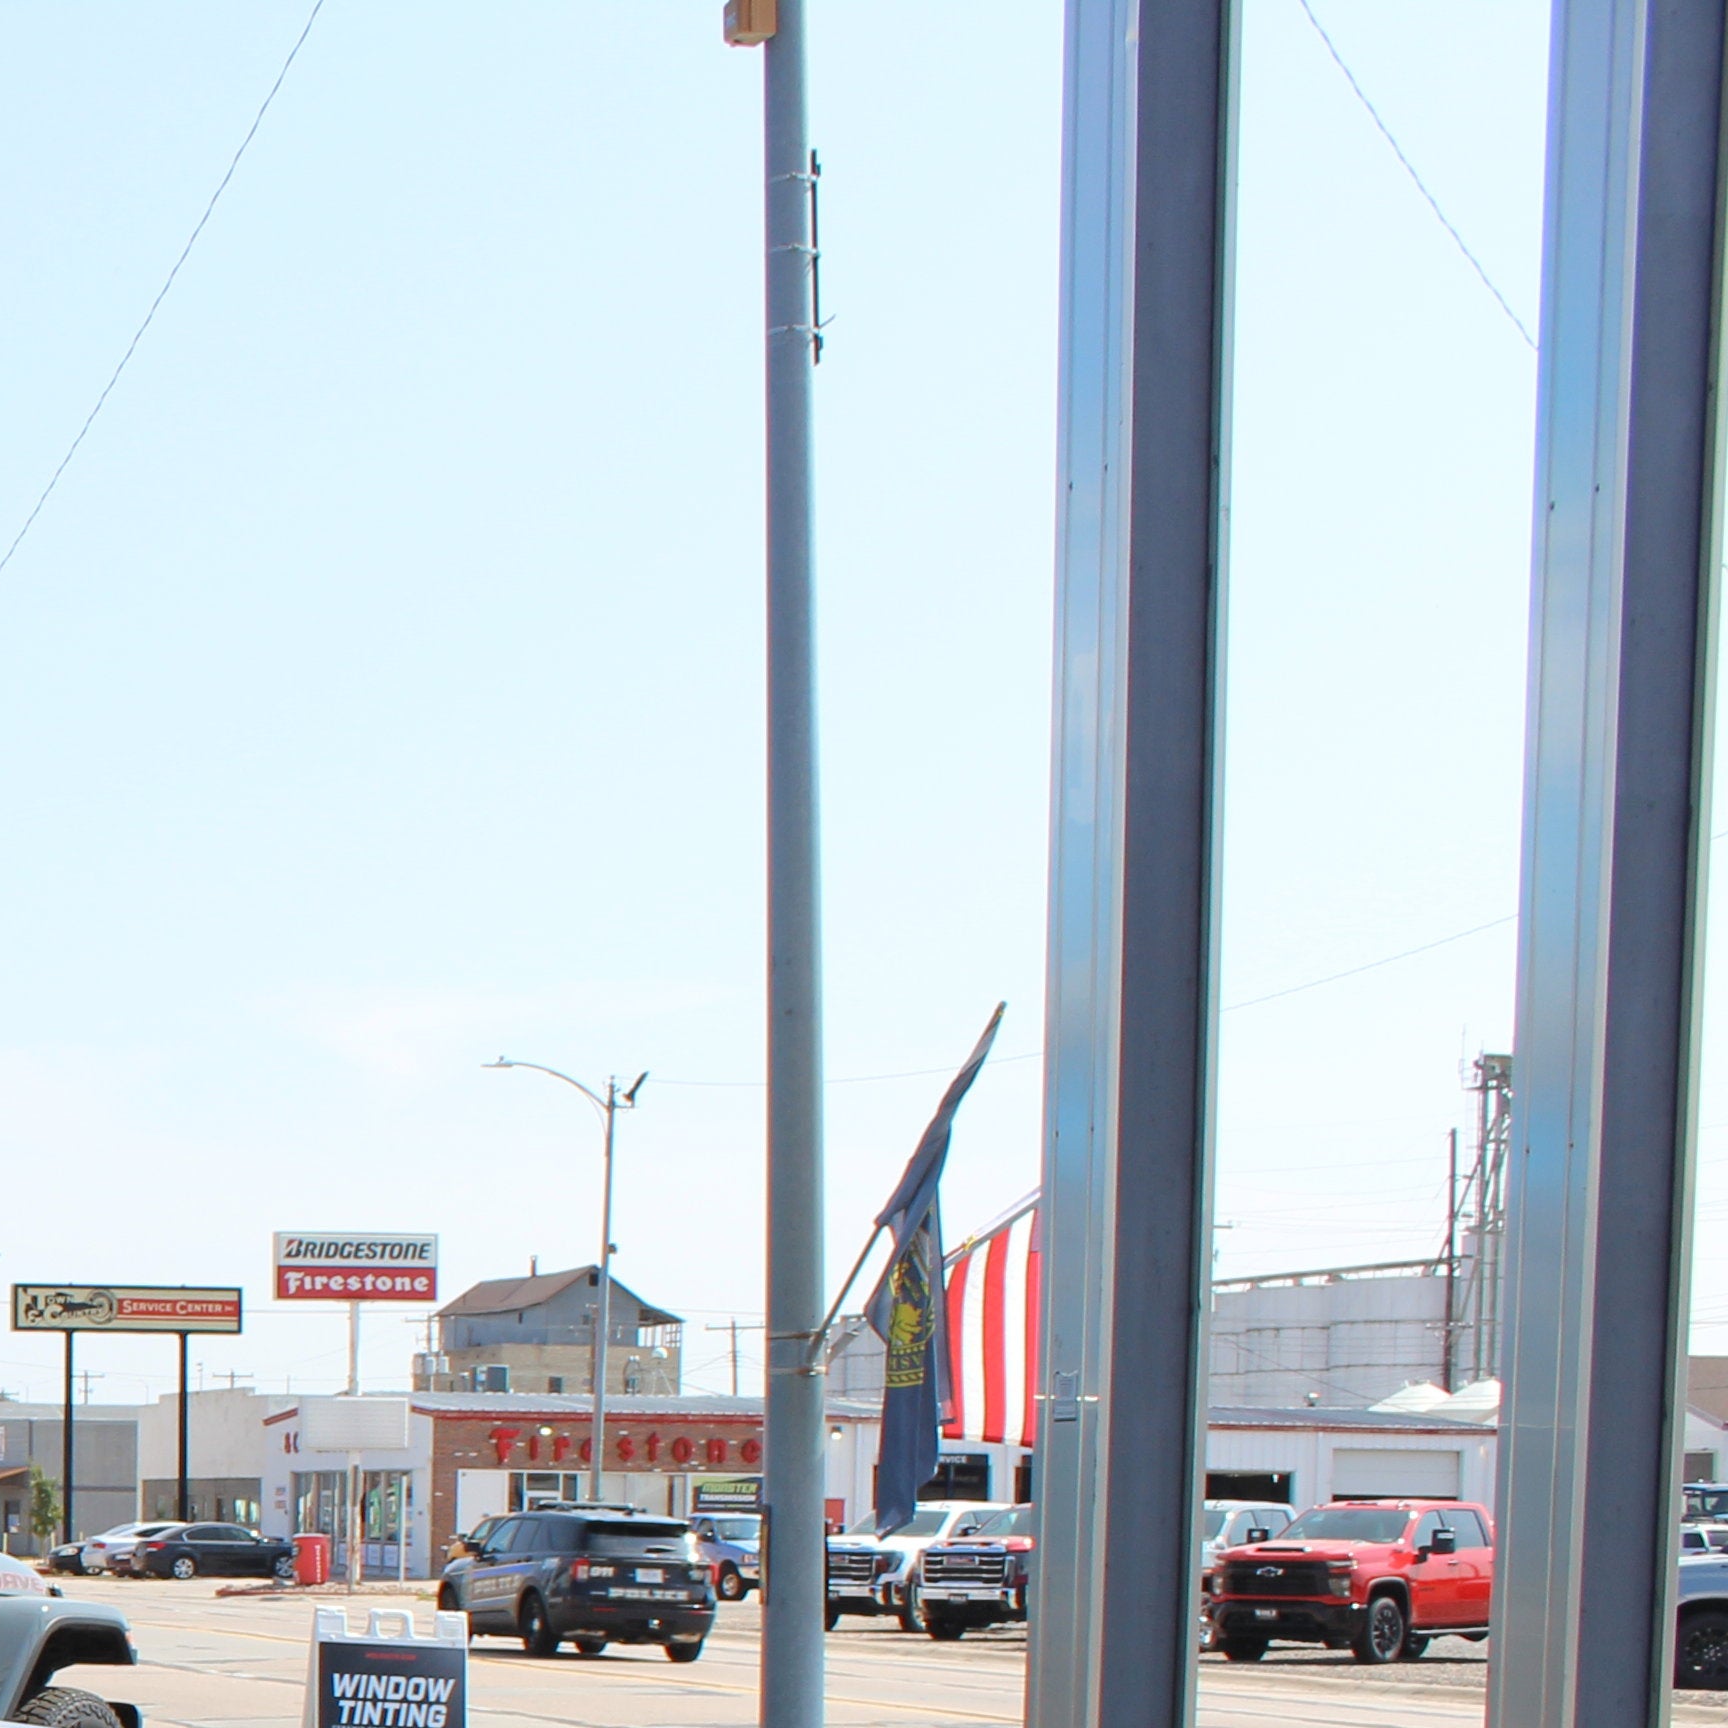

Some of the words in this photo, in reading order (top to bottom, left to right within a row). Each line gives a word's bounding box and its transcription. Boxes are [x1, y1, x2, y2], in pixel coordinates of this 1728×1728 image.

[284, 1238, 432, 1261] BRIDGESTONE
[283, 1270, 430, 1296] Firestone
[331, 1673, 456, 1704] WINDOW
